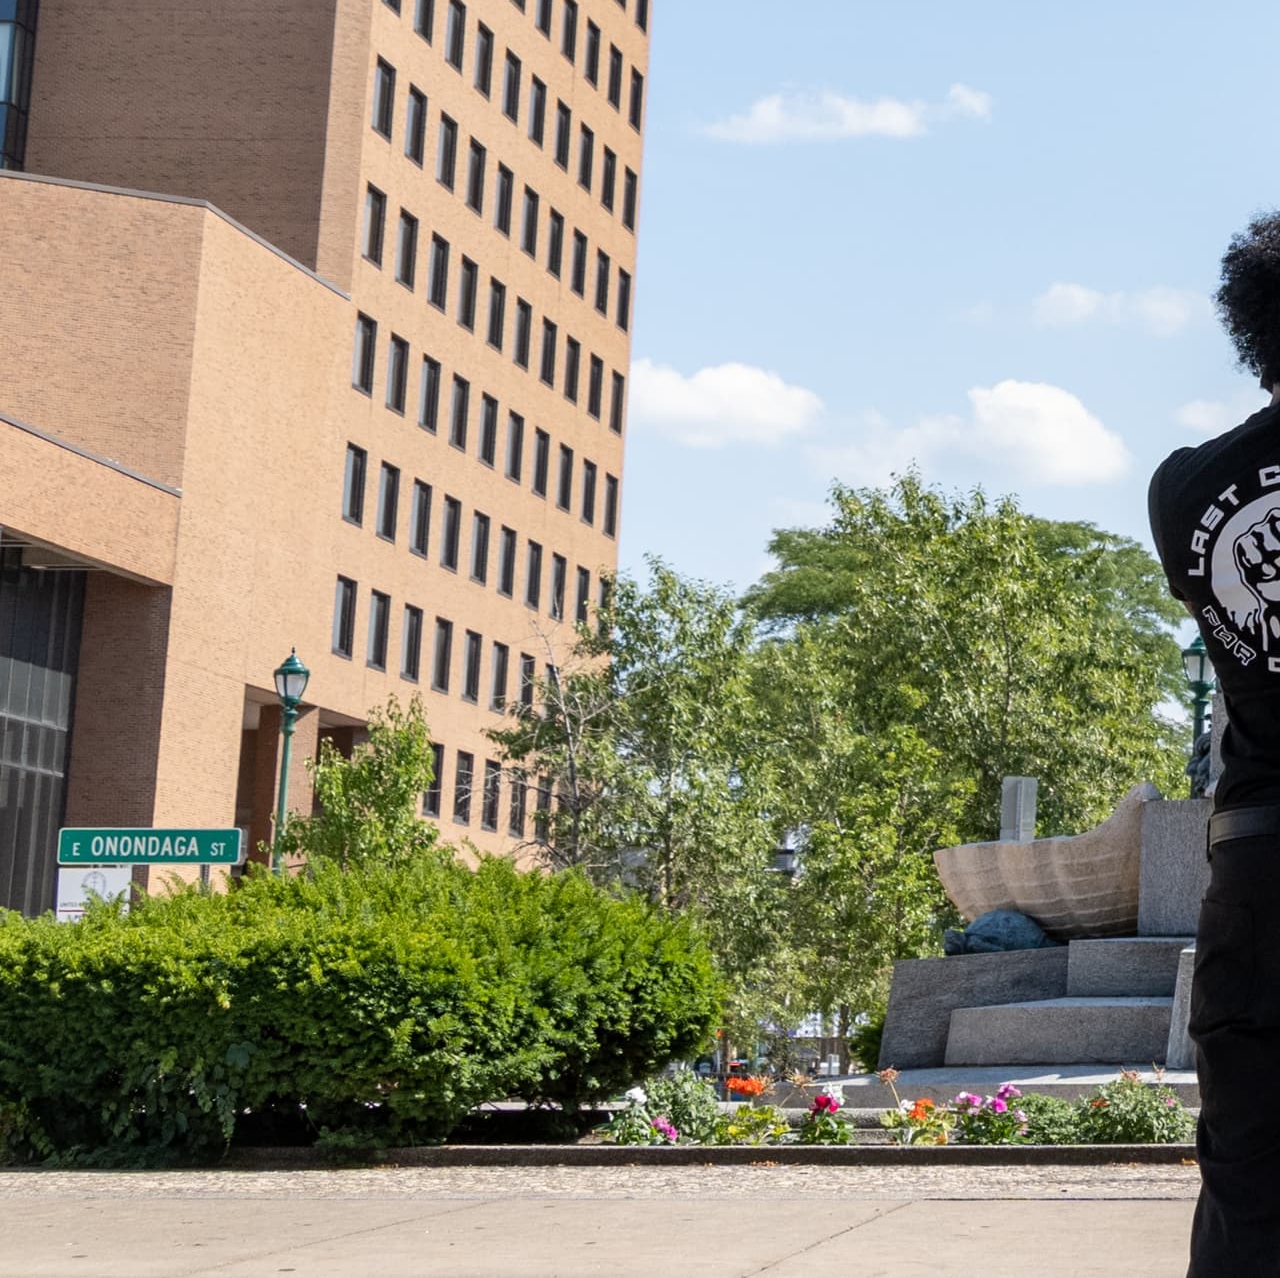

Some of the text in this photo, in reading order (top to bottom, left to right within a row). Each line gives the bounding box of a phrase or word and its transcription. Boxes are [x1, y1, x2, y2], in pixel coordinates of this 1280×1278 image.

[1188, 484, 1240, 577] LAST
[1201, 605, 1257, 666] FOR
[72, 836, 226, 856] E ONONDAGA ST
